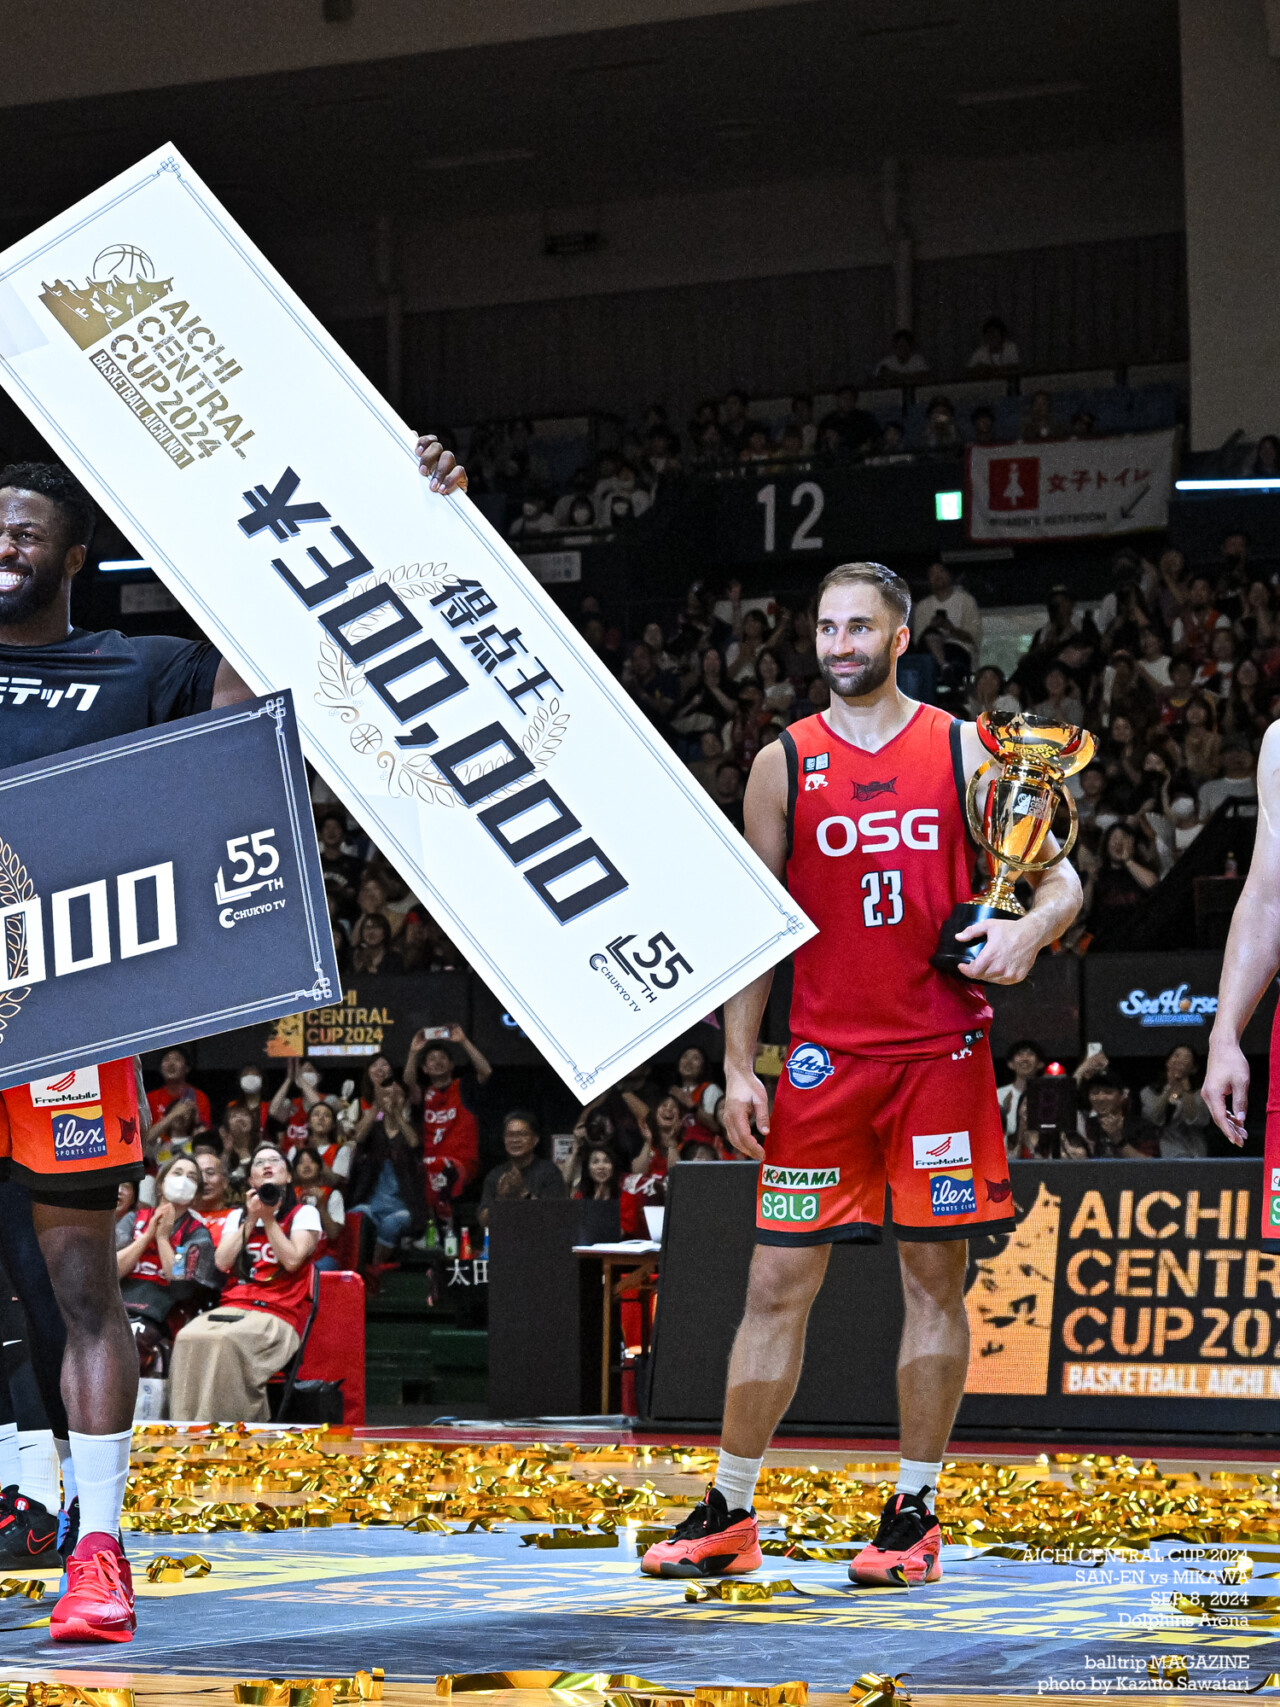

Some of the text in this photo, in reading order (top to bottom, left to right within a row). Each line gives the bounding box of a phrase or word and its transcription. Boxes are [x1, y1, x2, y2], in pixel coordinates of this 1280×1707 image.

[159, 300, 243, 384] AICHI
[92, 352, 191, 465] BASKETBALL AICHI NO.1
[110, 334, 222, 459] CUP 2024
[137, 316, 255, 460] CENTRAL
[1047, 467, 1150, 494] 女子トイレ
[757, 481, 825, 552] 12
[429, 578, 564, 715] 得点王
[237, 466, 629, 926] ¥300,000
[226, 828, 280, 883] 55
[816, 808, 939, 857] OSG
[266, 877, 284, 892] TH
[860, 869, 905, 928] 23
[233, 899, 286, 921] CHUKYO TV
[633, 931, 694, 989] 55
[601, 966, 641, 1013] CHUKYO TV
[641, 985, 658, 1003] TH
[306, 1007, 395, 1026] CENTRAL
[306, 1026, 384, 1044] CUP 2024
[34, 1091, 98, 1104] FreeMobile
[55, 1145, 107, 1157] SPORTS CLUB
[56, 1118, 105, 1148] ilex
[764, 1169, 837, 1186] KAYAMA
[915, 1156, 969, 1166] FreeMobile
[931, 1180, 975, 1204] ilex
[932, 1203, 976, 1213] SPORTS CLUB
[1069, 1190, 1250, 1240] AICHI
[1066, 1249, 1280, 1299] CENTR
[1062, 1306, 1280, 1358] CUP 20
[1068, 1365, 1200, 1393] BASKETBALL
[1207, 1367, 1266, 1395] AICHI
